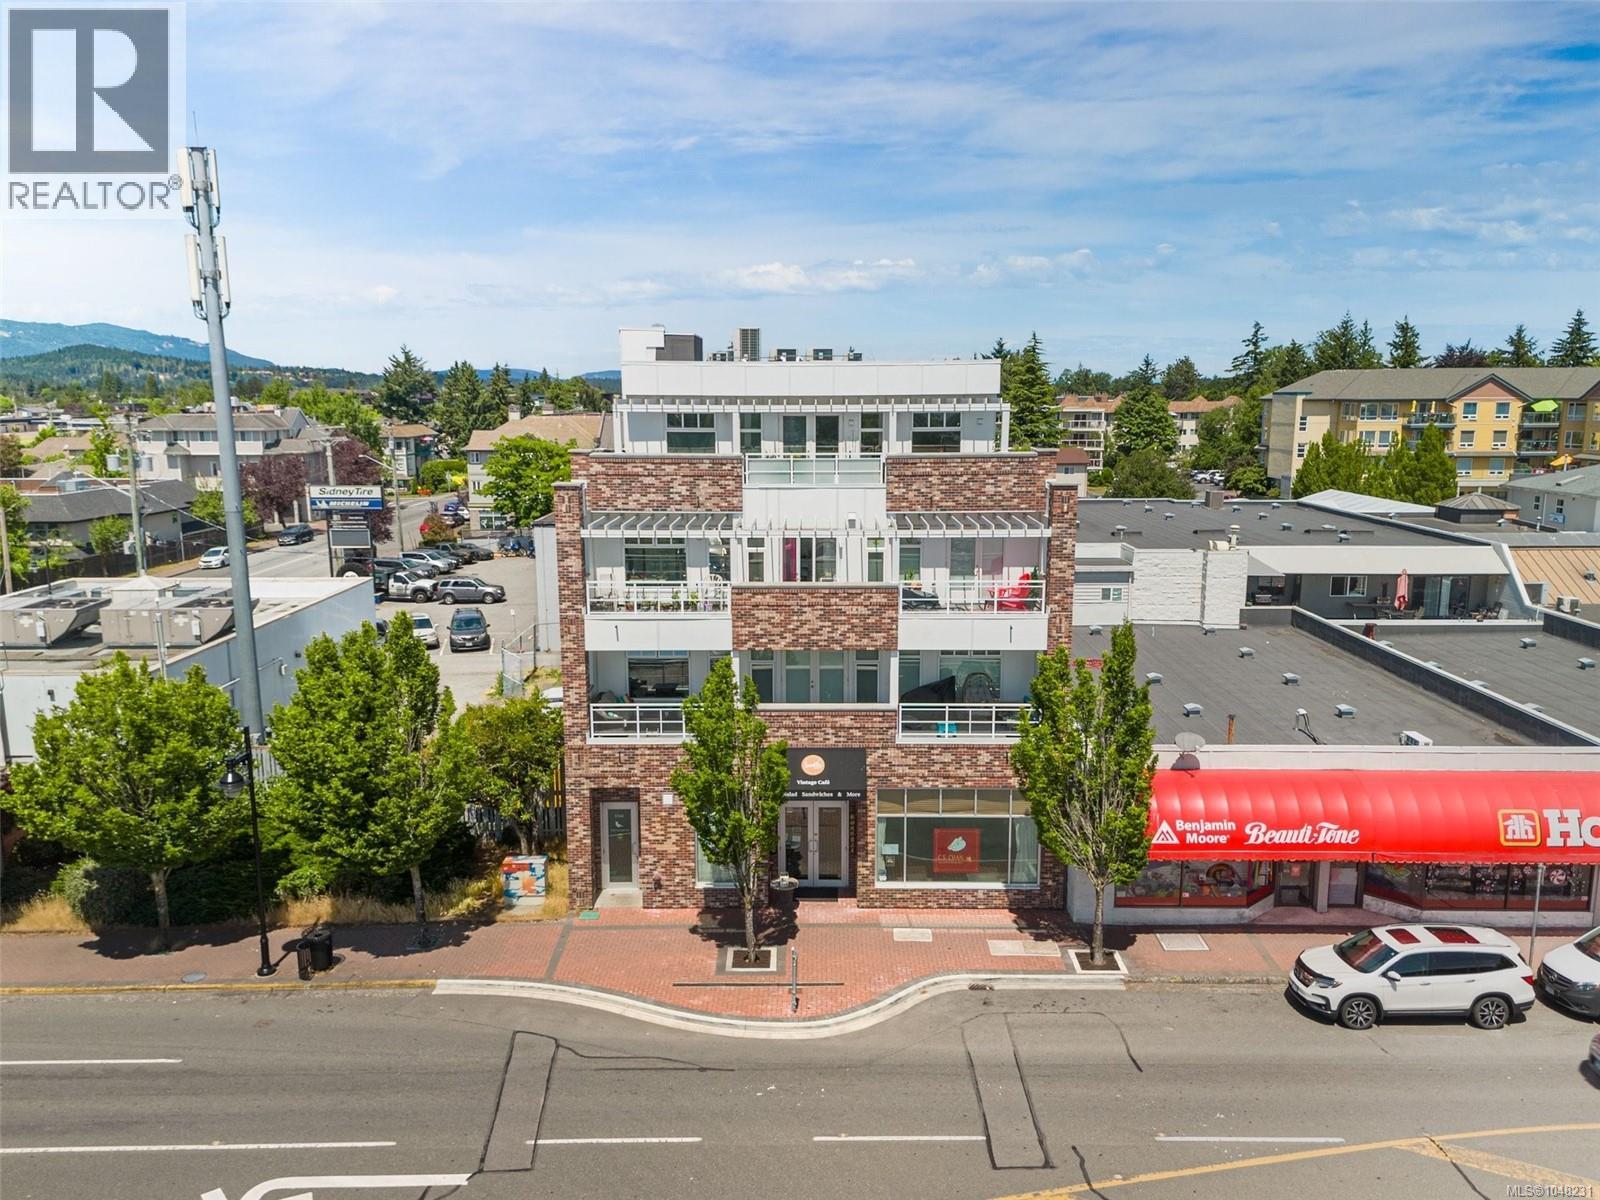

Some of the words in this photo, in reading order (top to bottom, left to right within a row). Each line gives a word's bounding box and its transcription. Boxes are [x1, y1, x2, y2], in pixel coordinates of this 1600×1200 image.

[318, 487, 353, 497] Sidney
[355, 487, 374, 496] Tire
[1175, 819, 1237, 833] Benjamin
